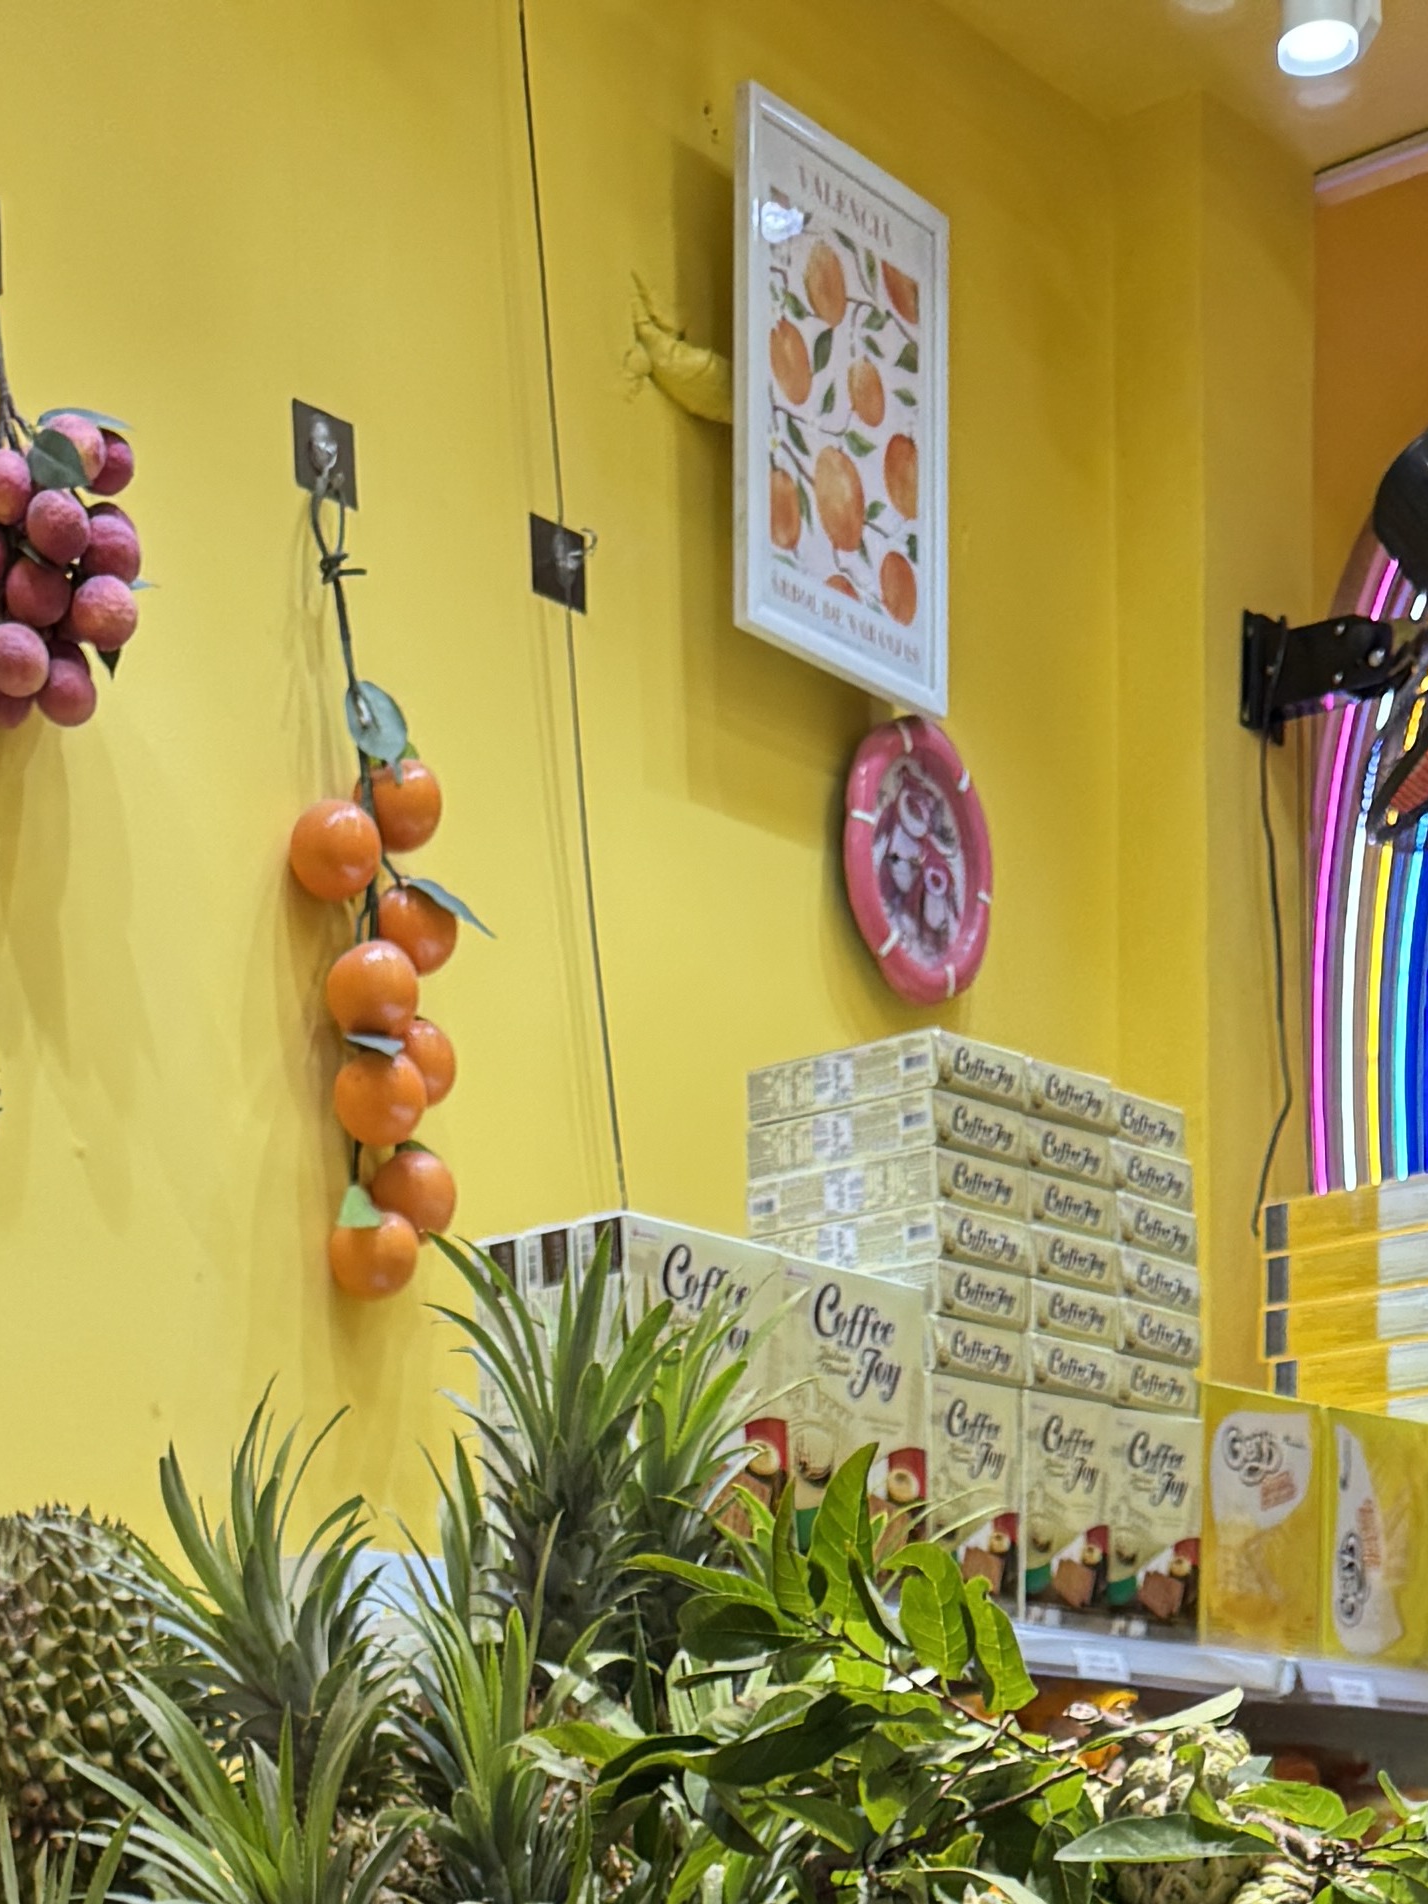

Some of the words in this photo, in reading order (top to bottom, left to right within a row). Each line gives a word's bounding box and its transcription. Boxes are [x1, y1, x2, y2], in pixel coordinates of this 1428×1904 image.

[813, 1282, 895, 1348] Coffee
[848, 1347, 902, 1403] Joy
[945, 1398, 1001, 1443] Coffee
[1041, 1415, 1096, 1458] Coffee
[969, 1442, 1006, 1479] Joy
[1128, 1430, 1185, 1474] Coffee
[1063, 1457, 1099, 1493] Joy
[1150, 1471, 1189, 1508] Joy
